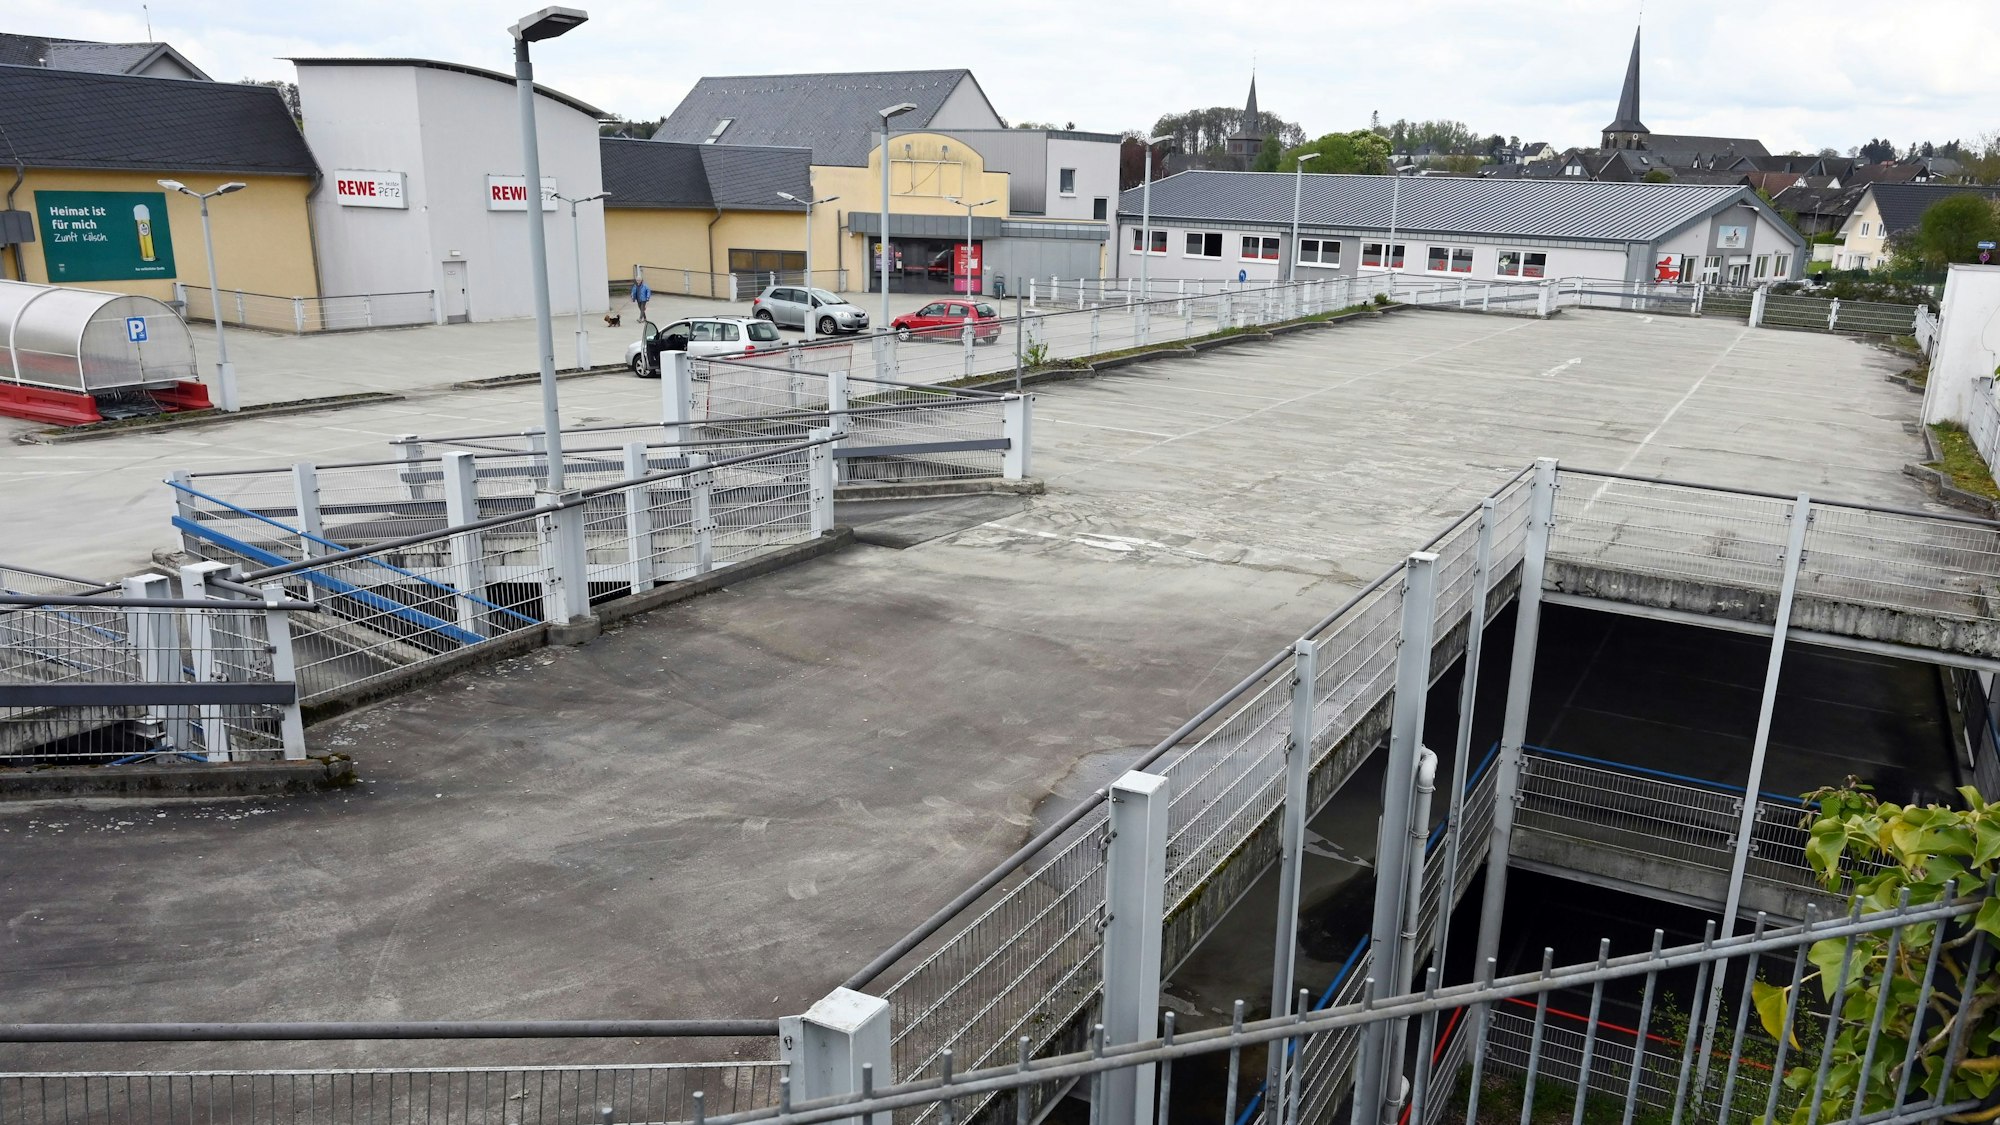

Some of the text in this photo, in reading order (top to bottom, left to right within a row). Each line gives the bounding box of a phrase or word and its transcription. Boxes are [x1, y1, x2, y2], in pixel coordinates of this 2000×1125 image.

[337, 180, 377, 197] REWE
[491, 185, 527, 201] REW
[50, 206, 106, 216] Heimat ist
[52, 219, 97, 229] für mich
[54, 231, 78, 242] Zunft
[129, 320, 144, 340] P
